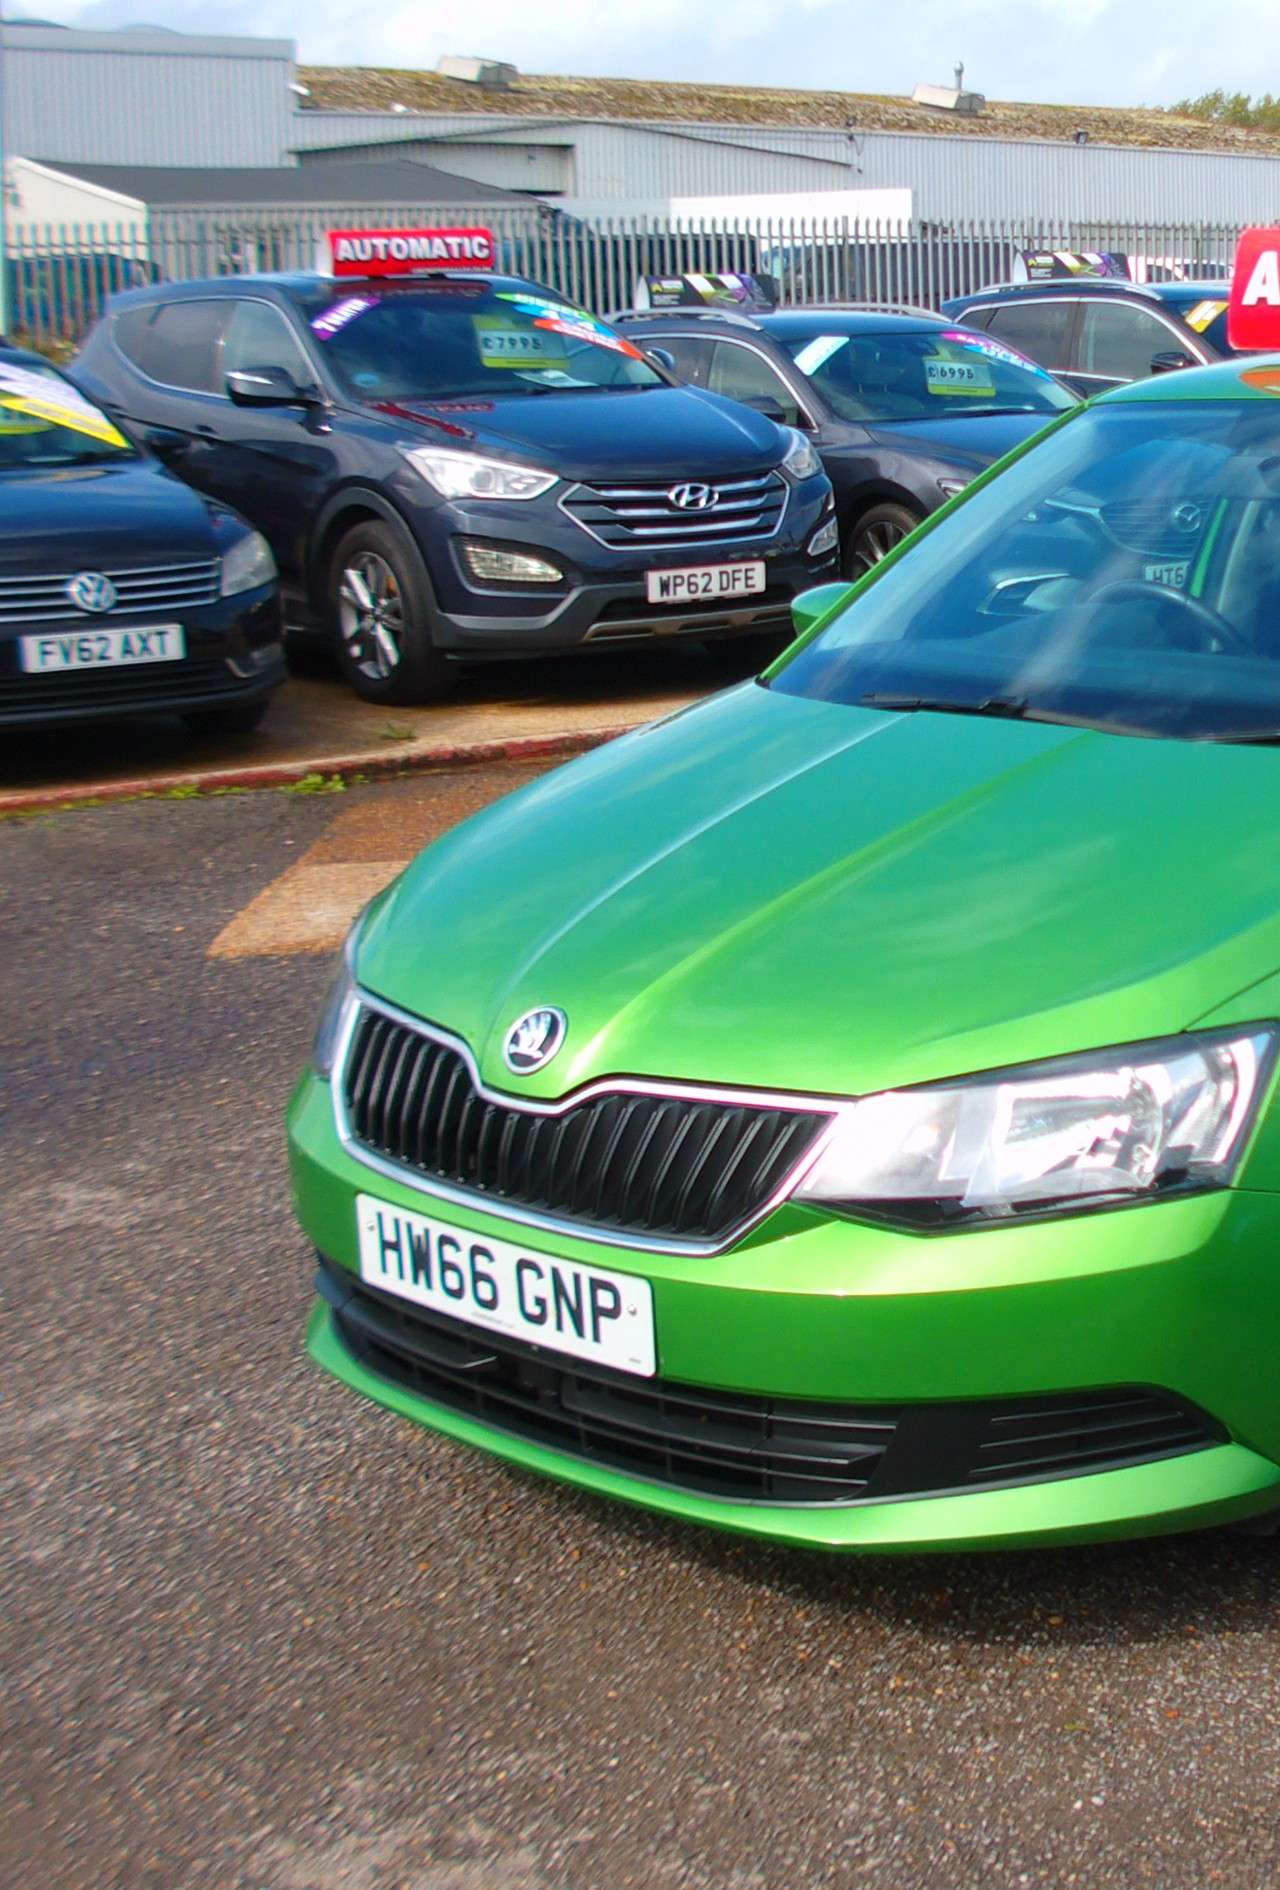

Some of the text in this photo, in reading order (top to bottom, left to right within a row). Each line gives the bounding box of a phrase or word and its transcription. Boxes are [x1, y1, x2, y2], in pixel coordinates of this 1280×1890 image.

[335, 235, 490, 262] AUTOMATIC
[659, 567, 756, 598] WP62 DFE
[38, 631, 169, 666] FV62 AXT
[376, 1211, 622, 1345] HW66 GNP
